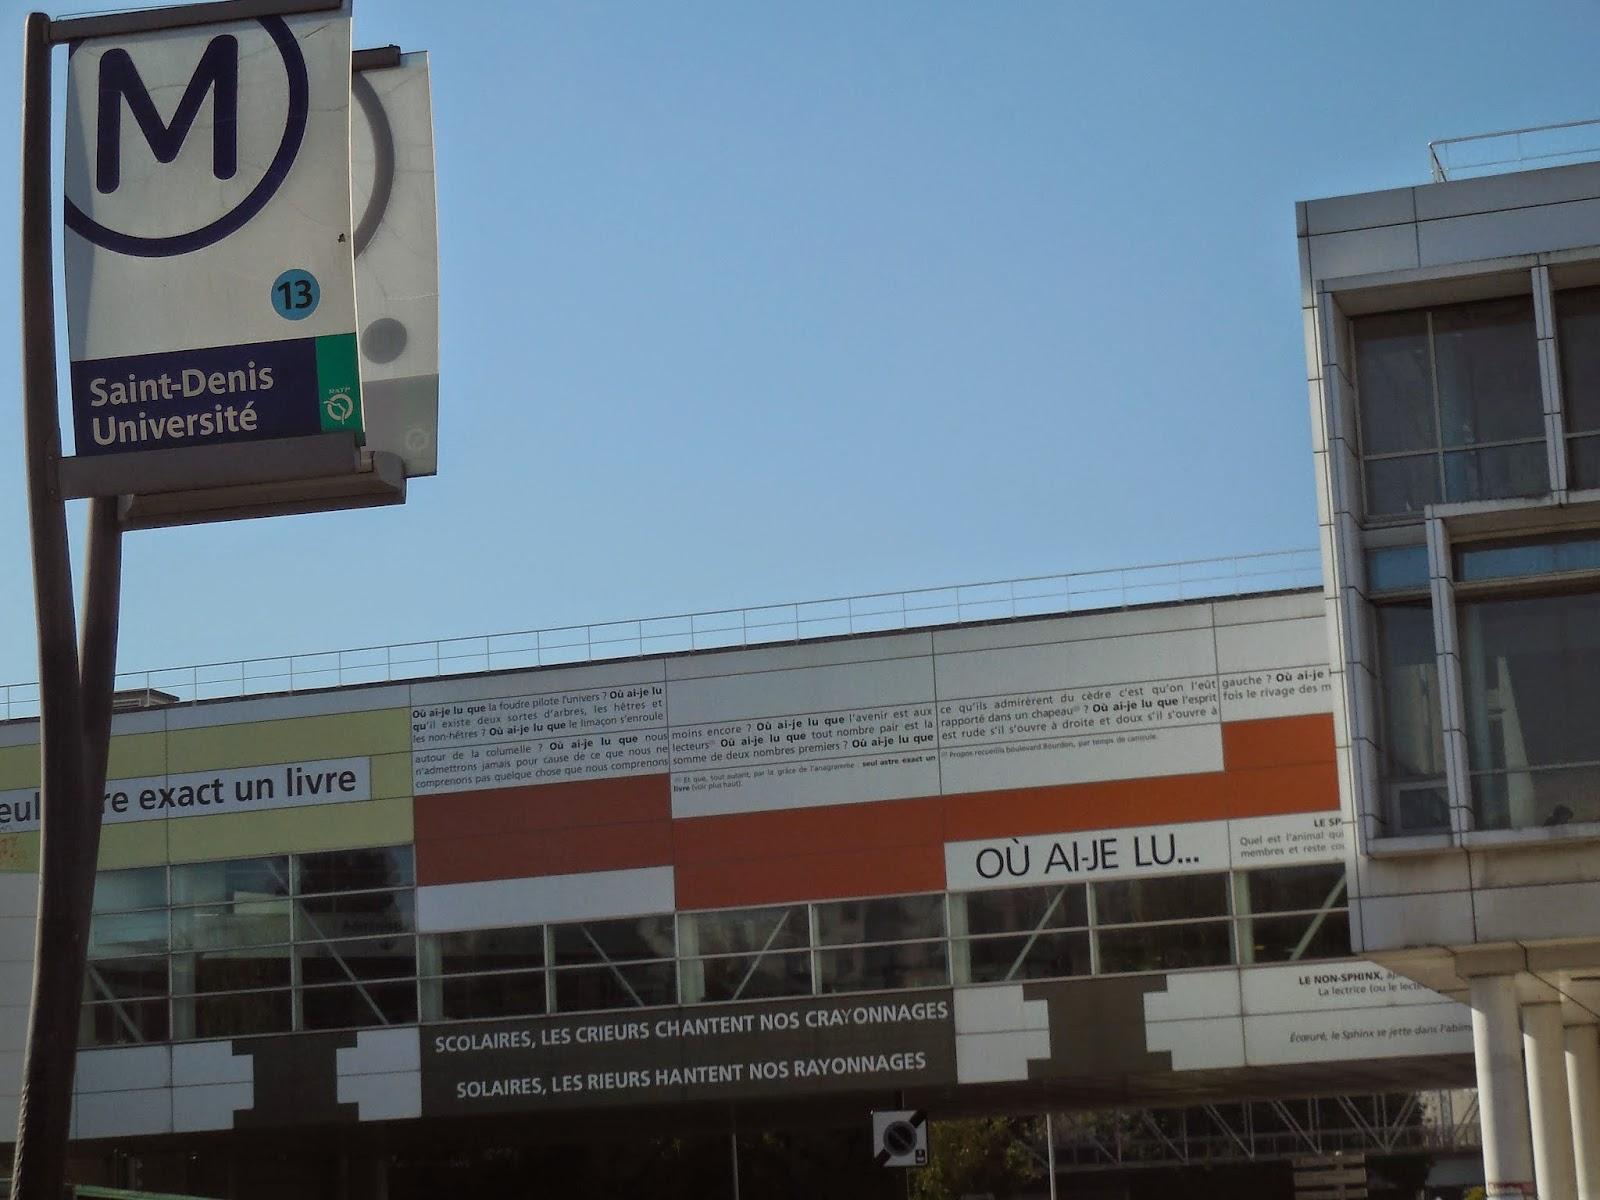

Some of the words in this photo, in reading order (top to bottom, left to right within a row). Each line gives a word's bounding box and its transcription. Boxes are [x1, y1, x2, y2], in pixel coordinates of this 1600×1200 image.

[97, 34, 238, 194] M
[278, 280, 312, 310] 13
[90, 361, 274, 406] Saint-Denis
[92, 401, 258, 446] Université
[1222, 676, 1262, 689] gauche
[1275, 672, 1292, 682] Où
[1297, 670, 1324, 680] ai-je
[1222, 689, 1243, 700] fois
[1246, 689, 1256, 698] le
[1260, 687, 1295, 697] rivage
[1298, 684, 1318, 693] des
[412, 709, 426, 718] Où
[429, 707, 450, 717] ai-je
[453, 706, 463, 714] lu
[467, 705, 486, 715] que
[488, 702, 496, 711] la
[499, 700, 529, 709] foudre
[532, 697, 559, 709] pilote
[562, 694, 599, 703] l'univers
[609, 689, 624, 699] Où
[626, 688, 649, 699] ai-je
[651, 686, 662, 695] lu
[941, 714, 984, 727] rapporté
[988, 713, 1011, 722] dans
[1092, 703, 1108, 712] Où
[1112, 700, 1137, 711] ai-je
[1141, 699, 1152, 708] lu
[1156, 698, 1178, 709] que
[1181, 693, 1216, 705] l'esprit
[958, 701, 987, 713] qu'ils
[1060, 693, 1074, 702] du
[1081, 690, 1111, 700] cèdre
[1118, 687, 1143, 697] c'est
[1151, 684, 1183, 696] qu'on
[1191, 680, 1216, 690] l'eût
[413, 732, 425, 743] les
[428, 730, 477, 741] non-hêtres
[489, 726, 503, 735] Où
[507, 724, 529, 735] ai-je
[533, 723, 543, 731] lu
[546, 722, 566, 732] que
[568, 720, 577, 728] le
[580, 718, 617, 727] limaçon
[620, 712, 663, 723] s'enroule
[441, 716, 470, 728] existe
[477, 715, 500, 724] deux
[507, 710, 537, 721] sortes
[593, 705, 607, 713] les
[613, 700, 645, 711] hêtres
[652, 699, 662, 709] et
[672, 729, 702, 738] moins
[706, 726, 741, 736] encore
[756, 721, 771, 731] Où
[777, 719, 802, 730] ai-je
[807, 717, 818, 726] lu
[824, 717, 844, 726] que
[849, 711, 887, 722] l'avenir
[893, 709, 908, 718] est
[941, 728, 956, 739] est
[961, 728, 985, 737] rude
[990, 725, 1004, 735] s'il
[1009, 724, 1046, 733] s'ouvre
[1062, 718, 1094, 728] droite
[1099, 716, 1110, 725] et
[1115, 714, 1143, 724] doux
[1147, 710, 1162, 720] s'il
[1167, 709, 1206, 719] s'ouvre
[415, 753, 445, 762] autour
[452, 751, 463, 759] de
[471, 749, 479, 758] la
[486, 744, 531, 756] columelle
[549, 741, 564, 750] Où
[570, 738, 593, 749] ai-je
[600, 737, 610, 745] lu
[618, 736, 638, 746] que
[645, 732, 668, 741] nous
[720, 737, 735, 747] Où
[741, 735, 763, 746] ai-je
[769, 734, 780, 742] lu
[786, 731, 806, 743] que
[811, 727, 832, 738] tout
[836, 726, 874, 736] nombre
[879, 723, 898, 734] pair
[904, 721, 918, 730] est
[924, 719, 932, 728] la
[481, 759, 510, 771] jamais
[516, 758, 538, 768] pour
[543, 755, 569, 763] cause
[573, 750, 585, 760] de
[605, 750, 623, 759] que
[656, 744, 668, 754] ne
[673, 755, 706, 764] somme
[710, 752, 722, 761] de
[725, 750, 749, 759] deux
[753, 745, 795, 756] nombres
[798, 742, 839, 755] premiers
[851, 738, 867, 748] Où
[871, 736, 893, 747] ai-je
[898, 734, 909, 743] lu
[913, 734, 933, 744] que
[415, 777, 472, 788] comprenons
[475, 773, 490, 784] pas
[494, 771, 532, 782] quelque
[535, 768, 561, 777] chose
[564, 766, 582, 776] que
[610, 758, 668, 770] comprenons
[139, 778, 224, 810] exact
[235, 777, 274, 800] un
[286, 768, 356, 796] livre
[1313, 819, 1325, 827] LE
[976, 838, 1030, 878] OÙ
[1044, 838, 1118, 874] AI-JE
[1134, 834, 1200, 867] LU...
[1298, 976, 1310, 984] LE
[1314, 972, 1382, 983] NON-SPHINX,
[435, 1031, 535, 1051] SCOLAIRES,
[541, 1028, 571, 1044] LES
[575, 1022, 649, 1042] CRIEURS
[655, 1015, 754, 1037] CHANTENT
[760, 1012, 799, 1030] NOS
[805, 1002, 948, 1027] CRAYONNAGES
[456, 1077, 546, 1097] SOLAIRES,
[551, 1074, 582, 1091] LES
[587, 1070, 650, 1089] RIEURS
[655, 1064, 743, 1084] HANTENT
[749, 1061, 789, 1078] NOS
[793, 1052, 926, 1075] RAYONNAGES
